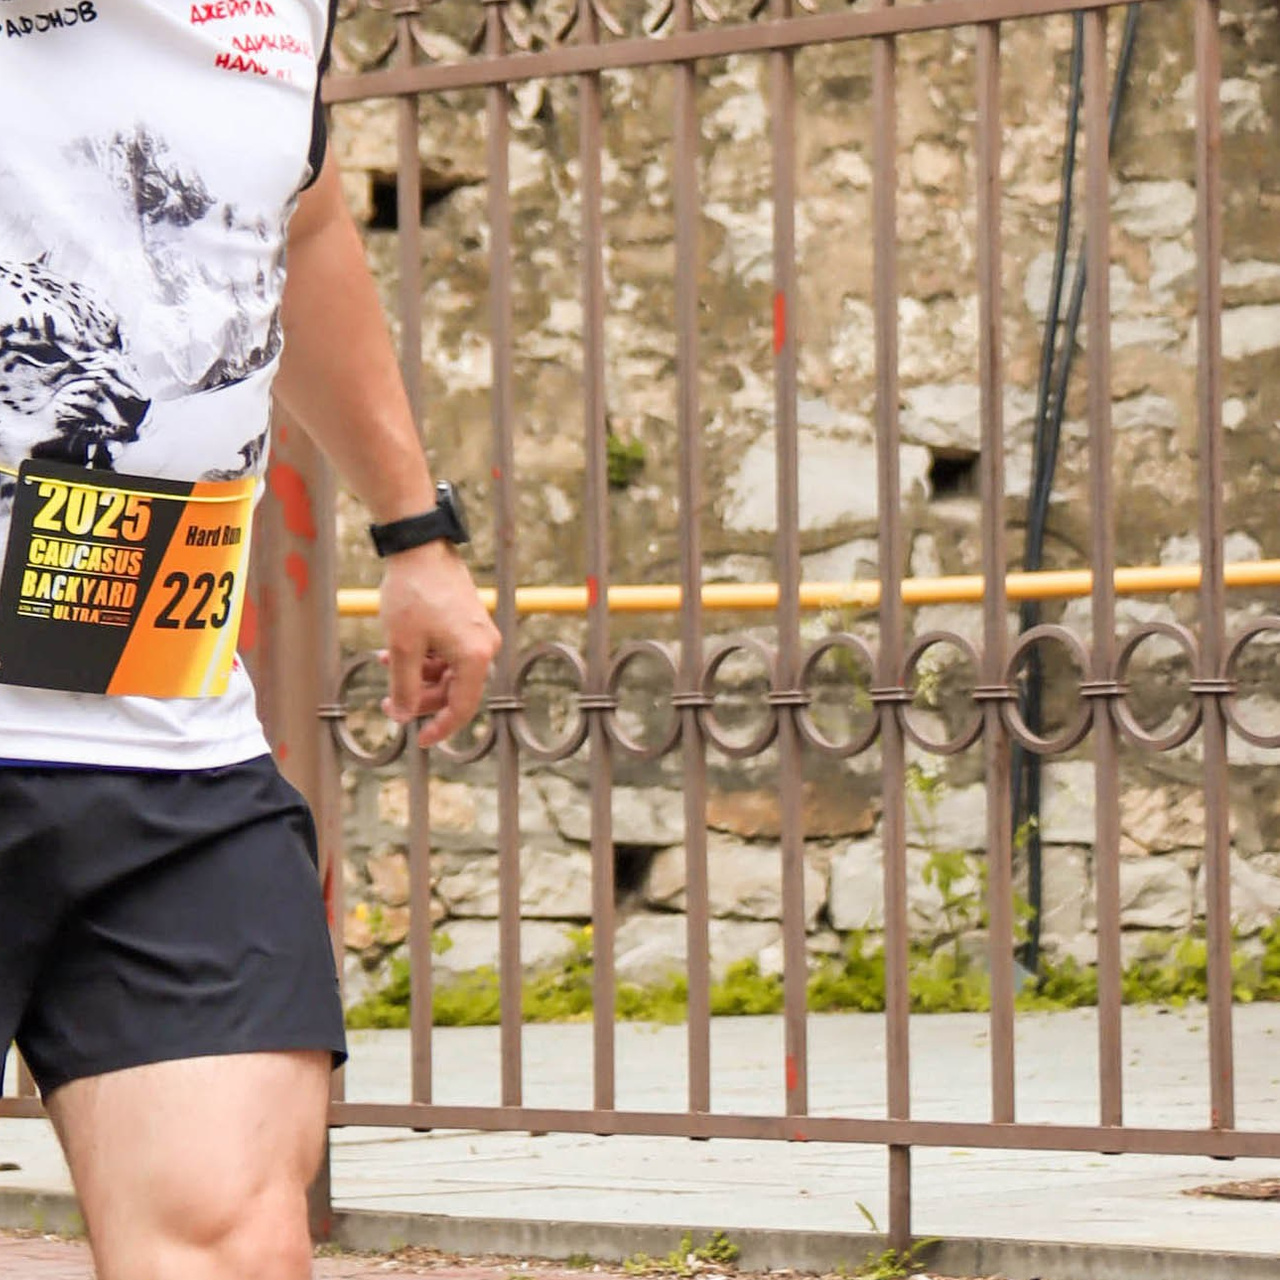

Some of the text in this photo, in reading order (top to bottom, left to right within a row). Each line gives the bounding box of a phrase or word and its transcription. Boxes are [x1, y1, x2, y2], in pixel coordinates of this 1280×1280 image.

[32, 480, 153, 542] 2025
[185, 524, 222, 547] Hard
[28, 538, 144, 577] CAUCASUS
[21, 570, 139, 609] BACKYARD
[153, 570, 236, 631] 223
[52, 603, 100, 624] ULTRA
